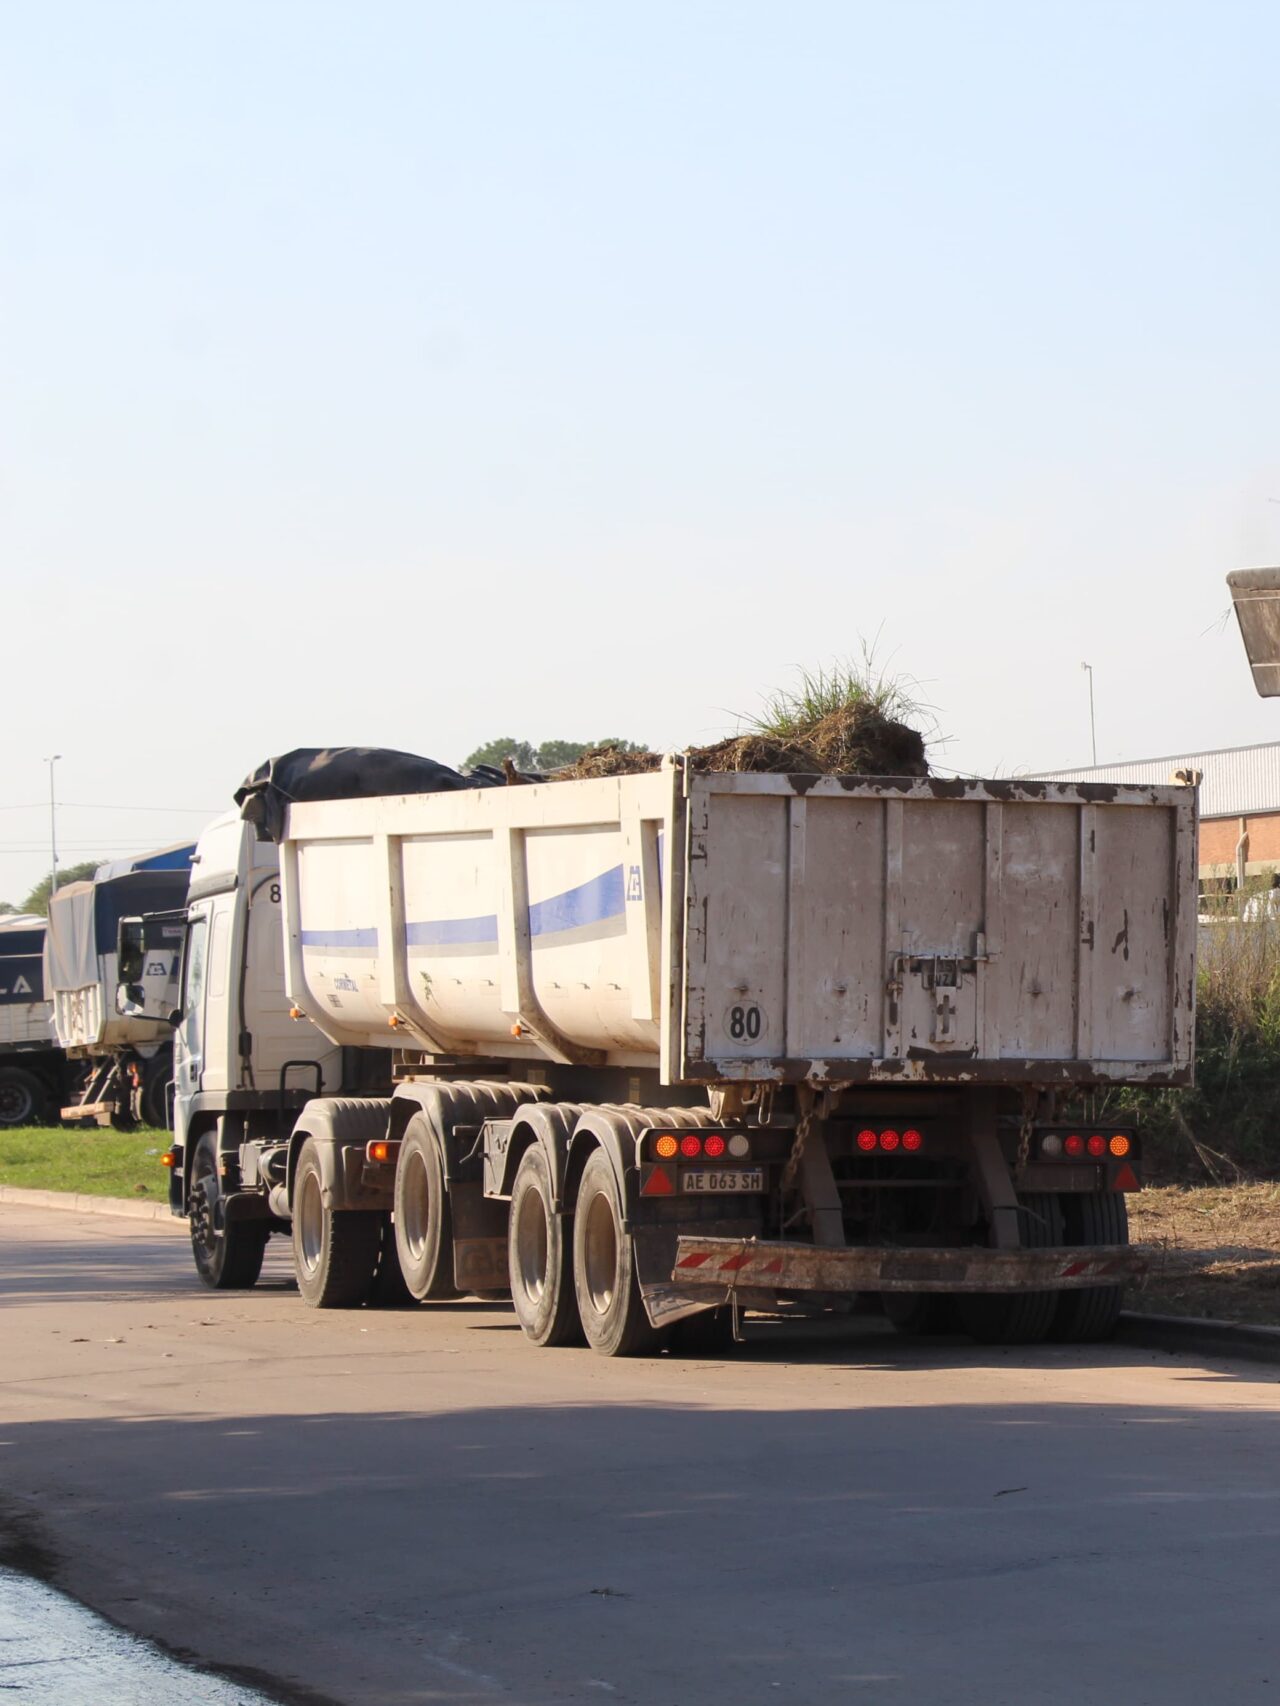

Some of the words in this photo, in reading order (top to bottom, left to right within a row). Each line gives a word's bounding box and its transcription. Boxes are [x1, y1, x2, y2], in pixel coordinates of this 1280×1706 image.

[730, 1006, 761, 1039] 80
[686, 1174, 704, 1190] AE
[709, 1174, 736, 1190] 063
[741, 1174, 760, 1189] SH
